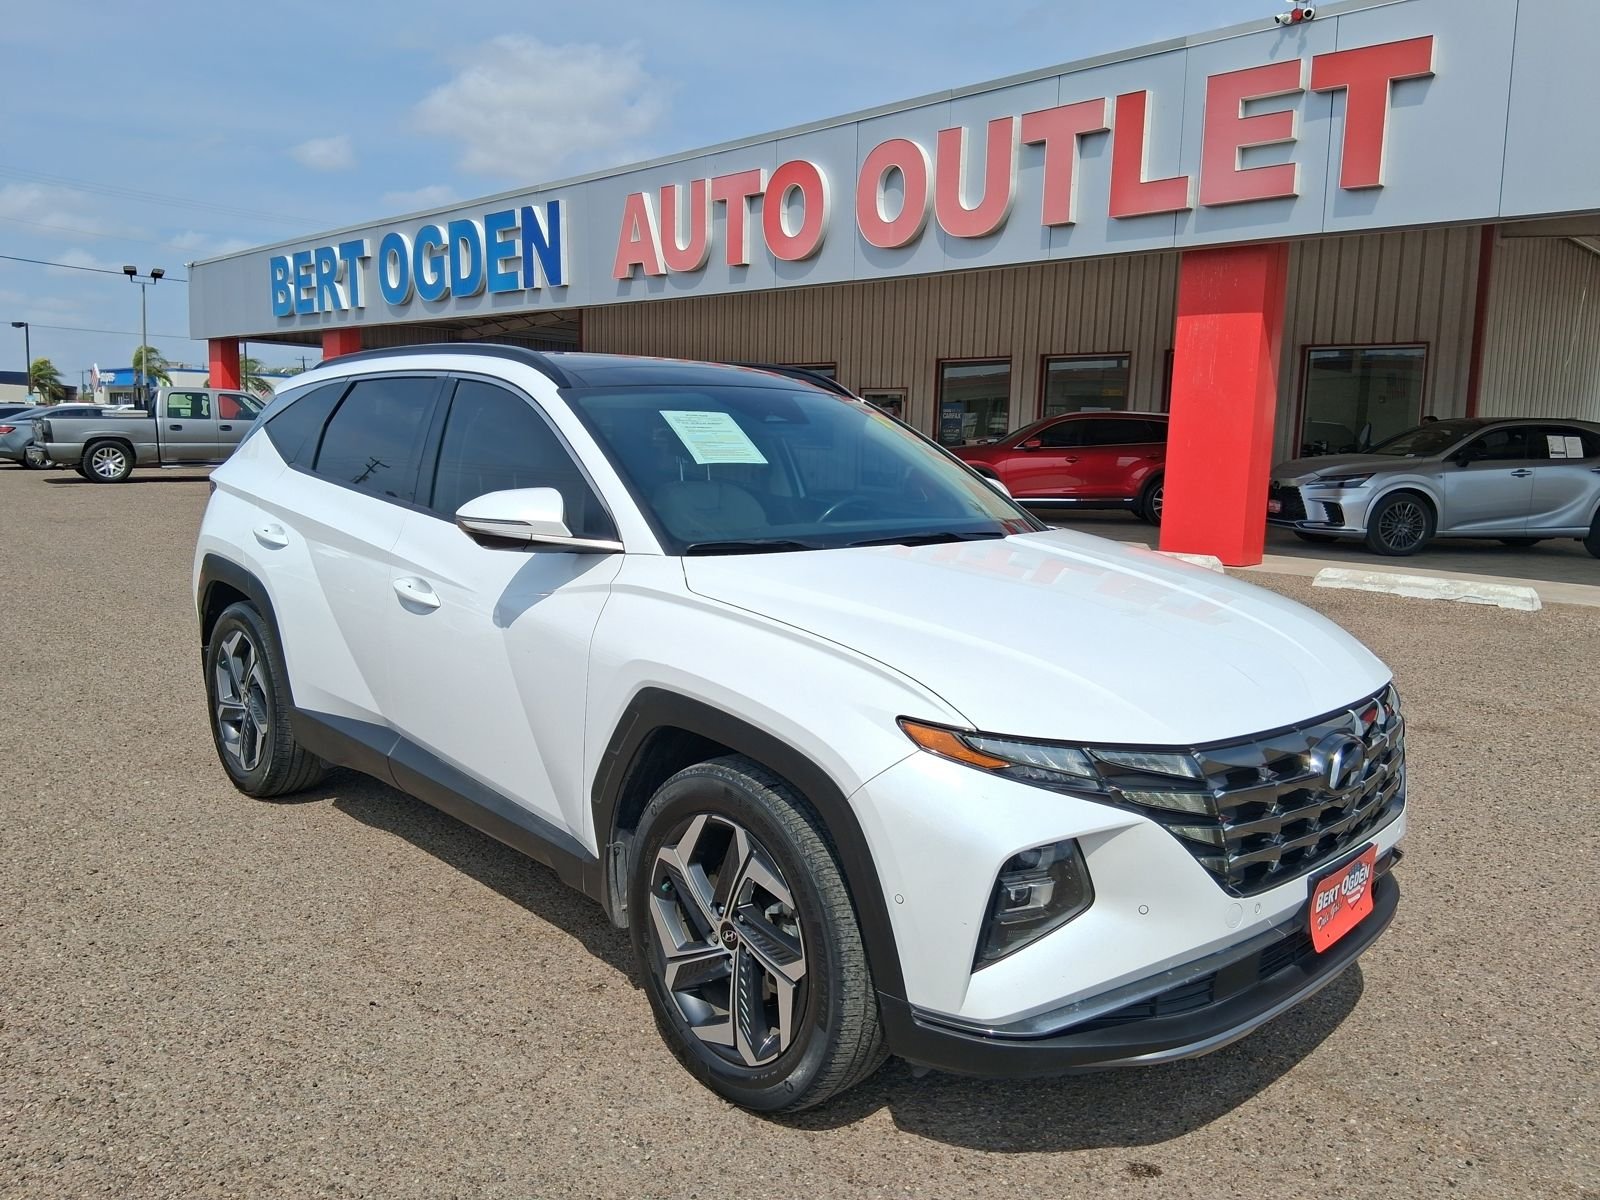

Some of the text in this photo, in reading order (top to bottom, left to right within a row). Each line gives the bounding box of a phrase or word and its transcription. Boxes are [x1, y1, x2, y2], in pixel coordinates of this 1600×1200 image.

[270, 35, 1436, 317] BERT OGDEN AUTO OUTLET
[1315, 862, 1370, 913] BERT OGDEN
